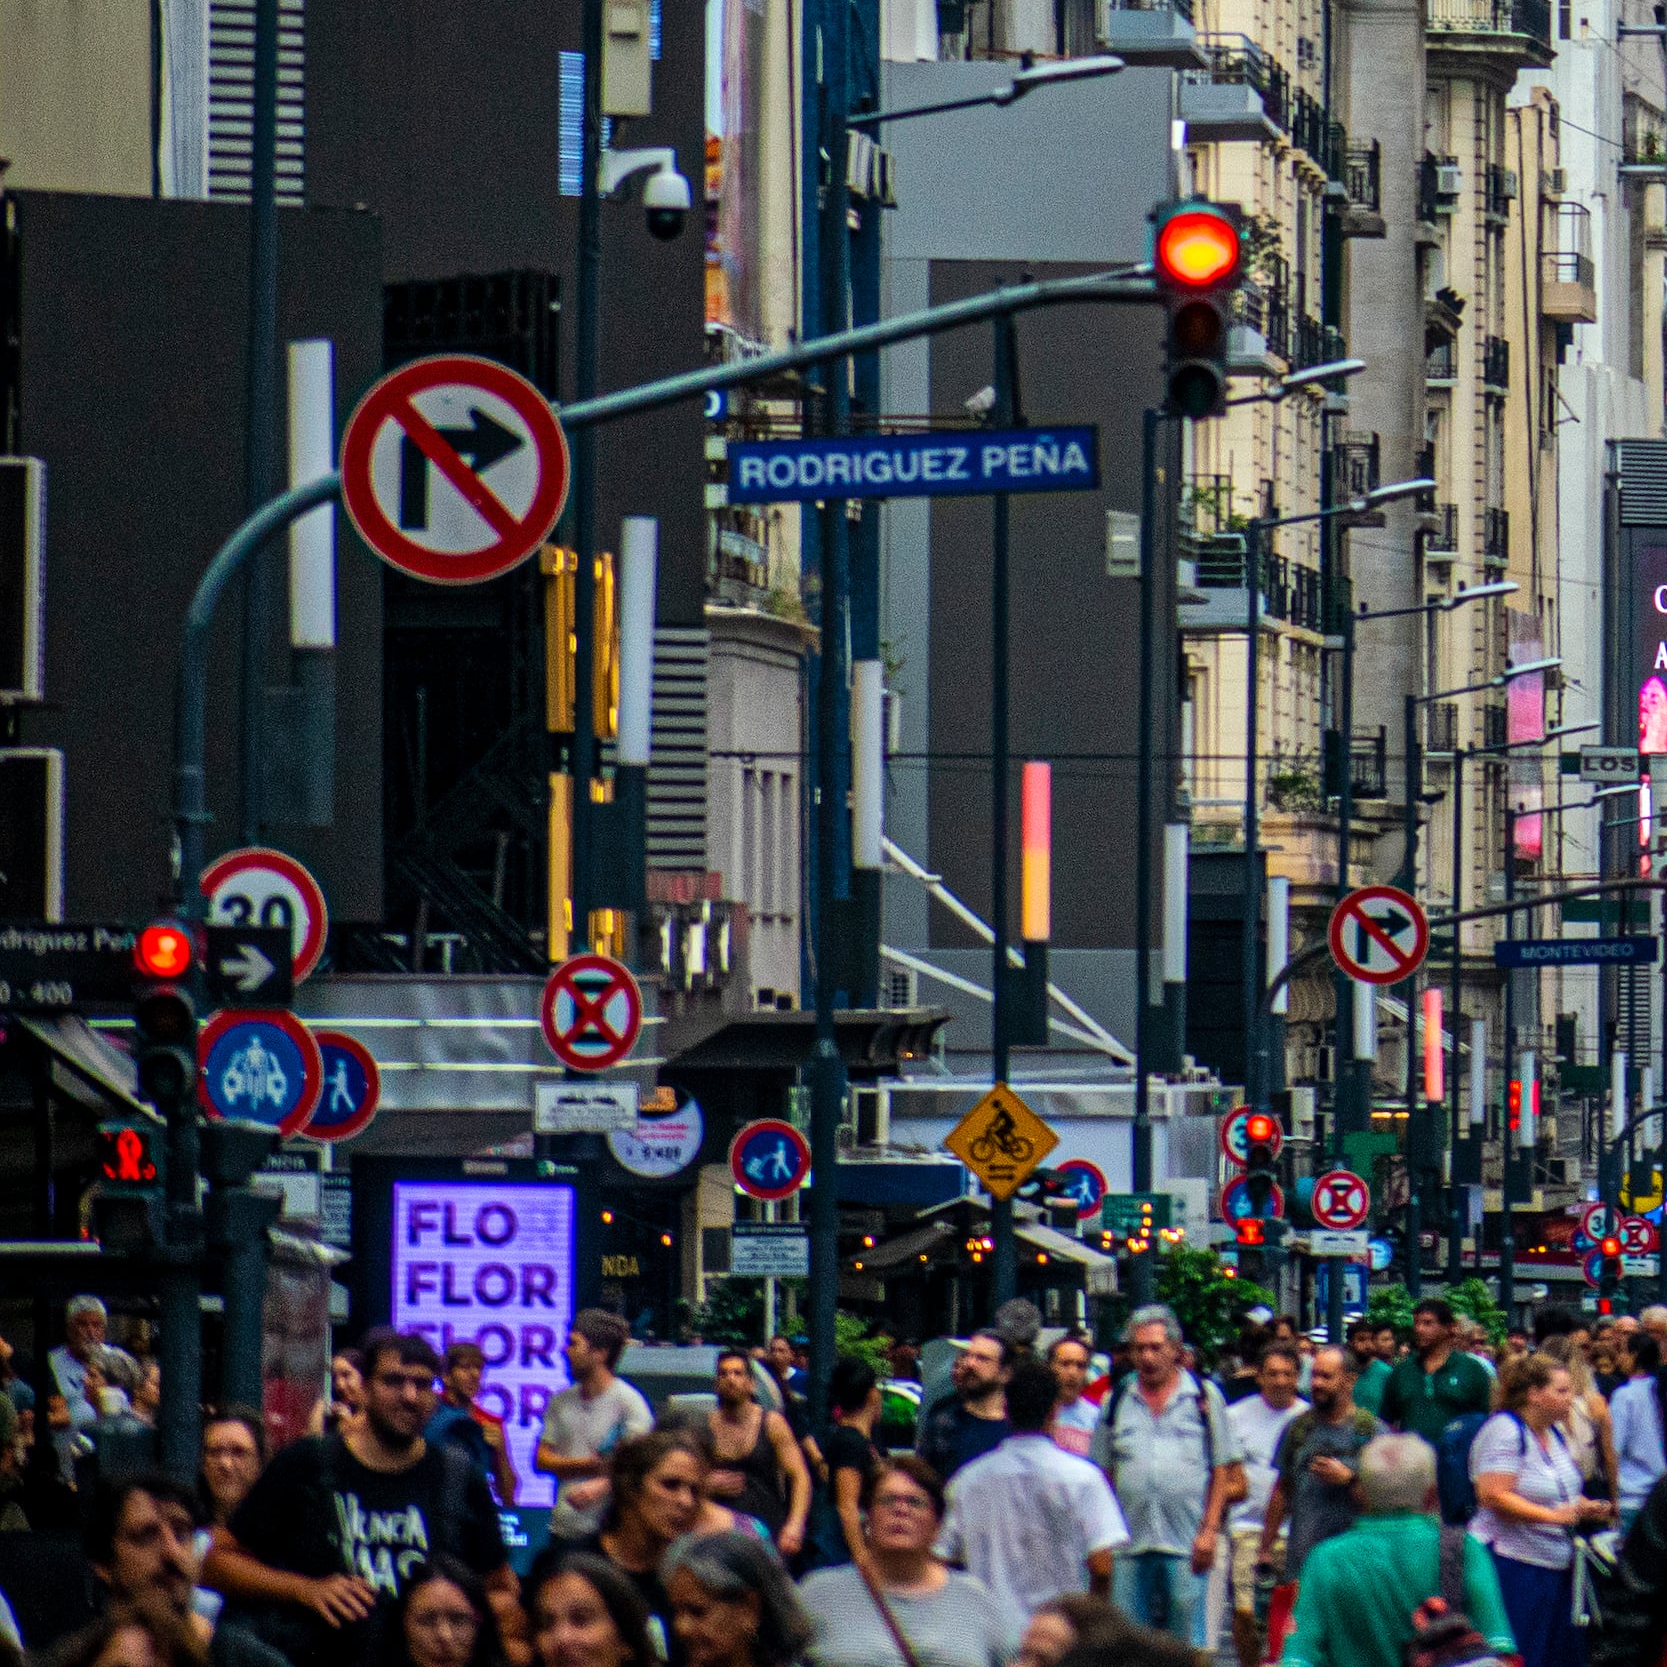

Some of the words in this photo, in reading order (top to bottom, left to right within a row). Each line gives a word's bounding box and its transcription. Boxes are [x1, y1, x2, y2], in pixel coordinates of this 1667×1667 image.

[738, 446, 970, 490] RODRIGUEZ
[981, 435, 1090, 477] PEÑA
[1583, 754, 1637, 773] LOS
[1519, 943, 1635, 959] MONTEVIDEO
[407, 1200, 518, 1248] FLO
[407, 1260, 558, 1308] FLOR
